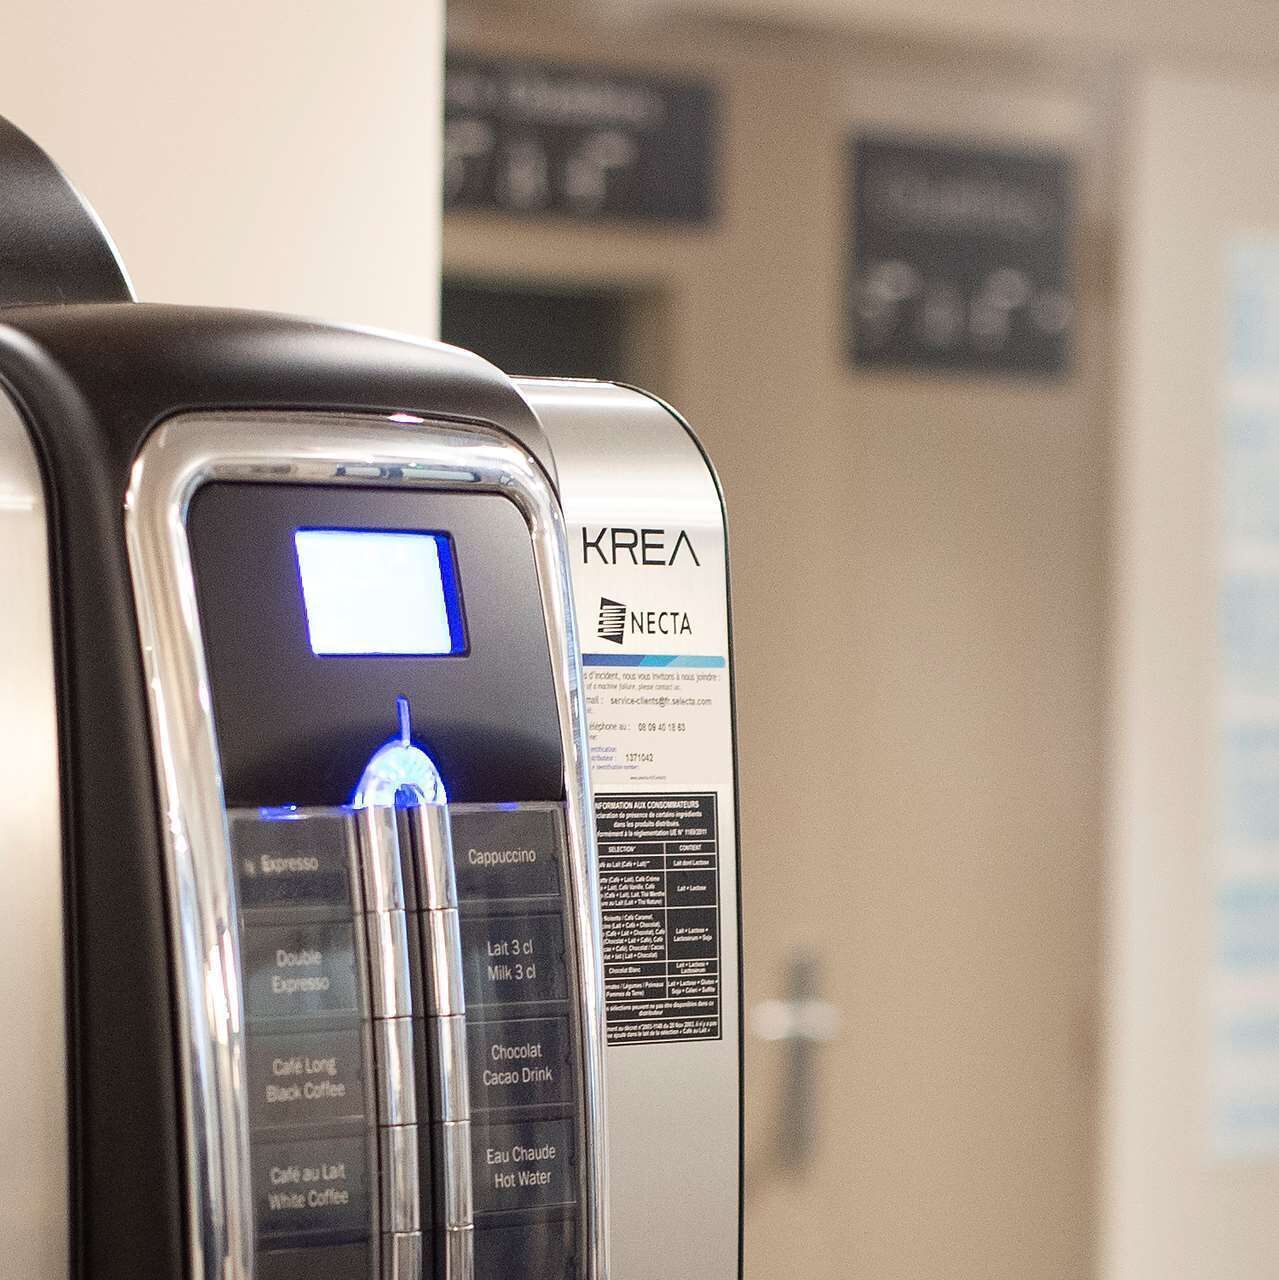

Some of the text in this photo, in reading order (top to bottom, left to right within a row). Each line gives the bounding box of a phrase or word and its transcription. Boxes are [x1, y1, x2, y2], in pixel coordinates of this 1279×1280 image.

[630, 611, 693, 635] NECTA
[260, 854, 319, 873] Expresso
[468, 848, 537, 867] Cappuccino
[487, 939, 534, 956] Lait 3 cl
[276, 949, 322, 967] Double
[487, 963, 537, 981] Milk 3 cl
[271, 975, 330, 994] Expresso
[491, 1043, 543, 1061] Chocolat
[272, 1056, 339, 1077] Café Long
[483, 1066, 553, 1087] Cacao Drink
[265, 1080, 347, 1104] Black Coffee
[486, 1143, 556, 1166] Eau Chaude
[270, 1162, 346, 1186] Café au Lait
[495, 1170, 552, 1190] Hot Water
[268, 1187, 350, 1211] White Coffee
